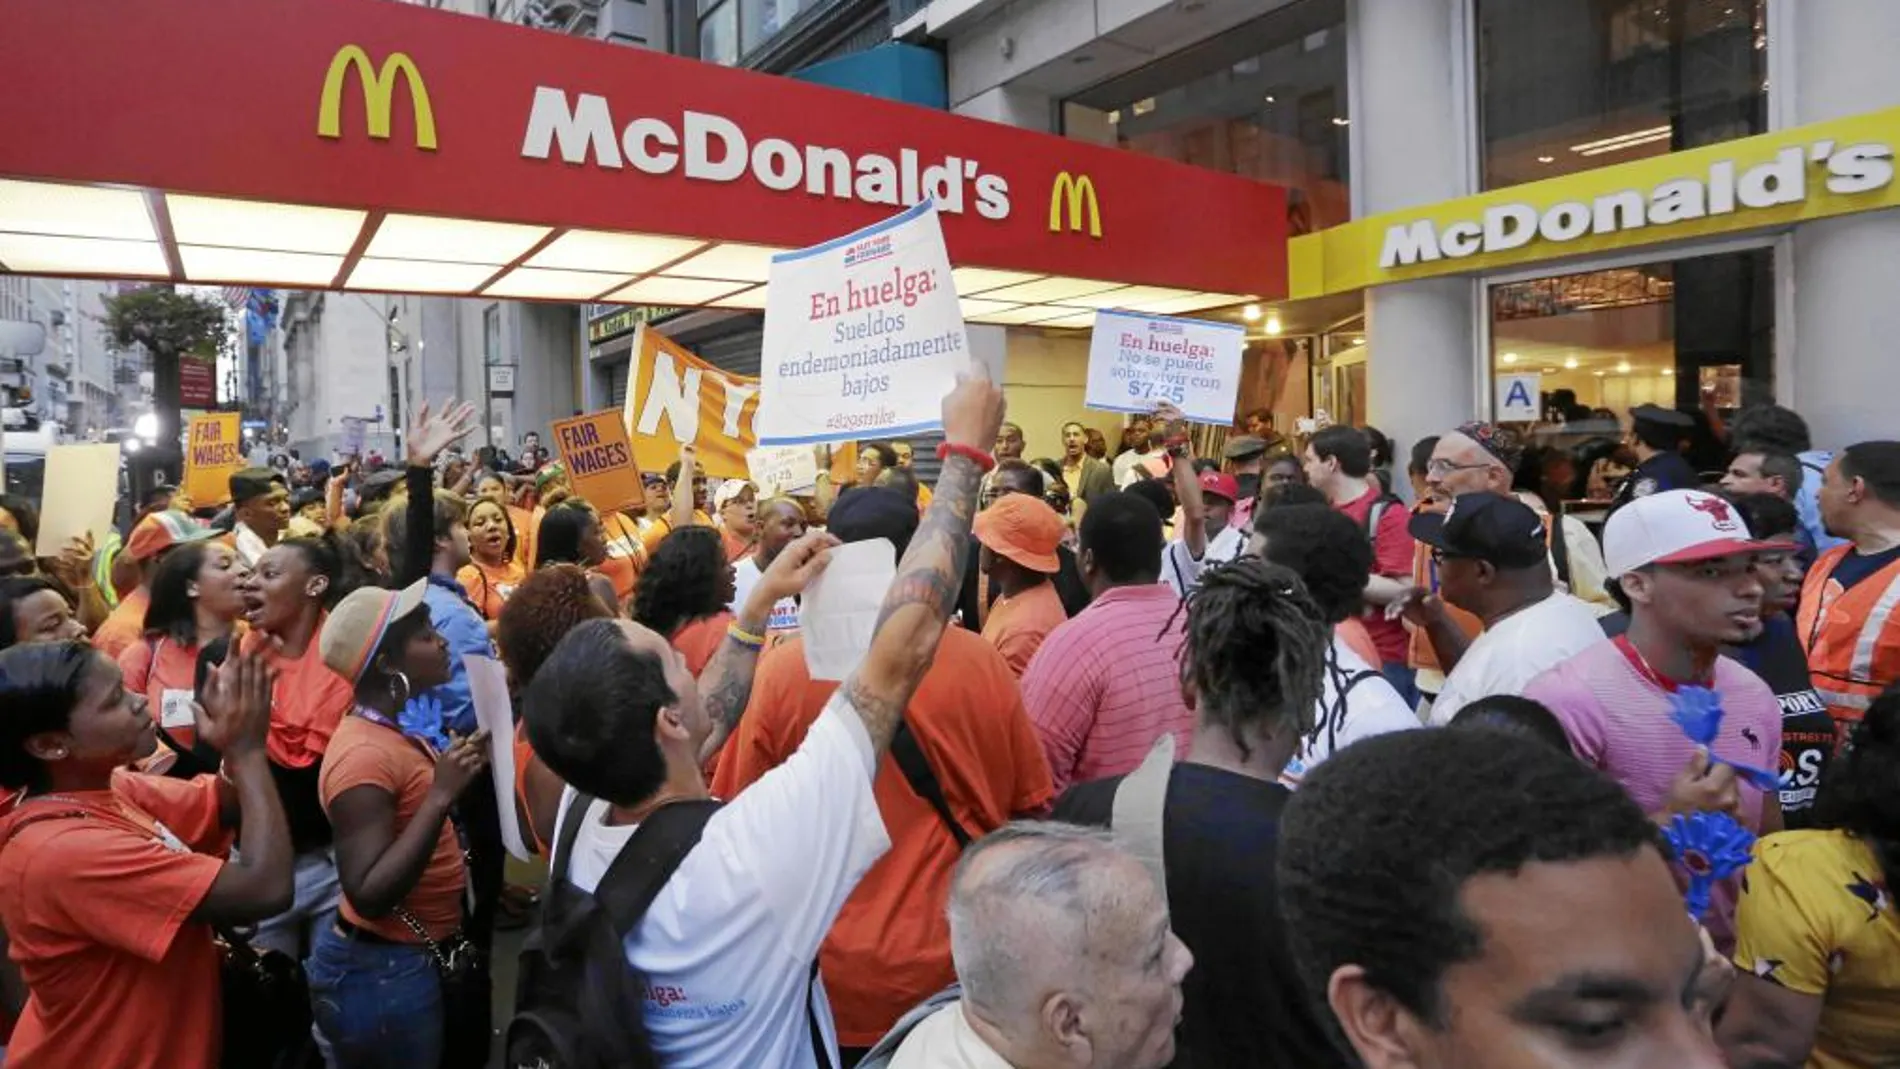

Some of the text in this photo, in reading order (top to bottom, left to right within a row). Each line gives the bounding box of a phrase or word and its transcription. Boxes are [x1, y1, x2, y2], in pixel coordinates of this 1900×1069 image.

[521, 86, 1010, 220] McDonald's
[1379, 139, 1895, 268] McDonald's
[808, 266, 937, 321] En huelga:
[834, 310, 906, 343] Sueldos
[778, 330, 962, 379] endemoniadamente
[1118, 349, 1214, 372] No se puede
[1119, 333, 1216, 360] En huelga:
[841, 372, 890, 401] bajos
[1127, 379, 1185, 404] $7.25
[1191, 376, 1220, 390] con
[1504, 380, 1532, 407] A
[826, 405, 896, 430] #829strike
[195, 421, 221, 443] FAIR
[561, 422, 600, 451] FAIR
[193, 443, 236, 466] WAGES
[568, 441, 629, 475] WAGES
